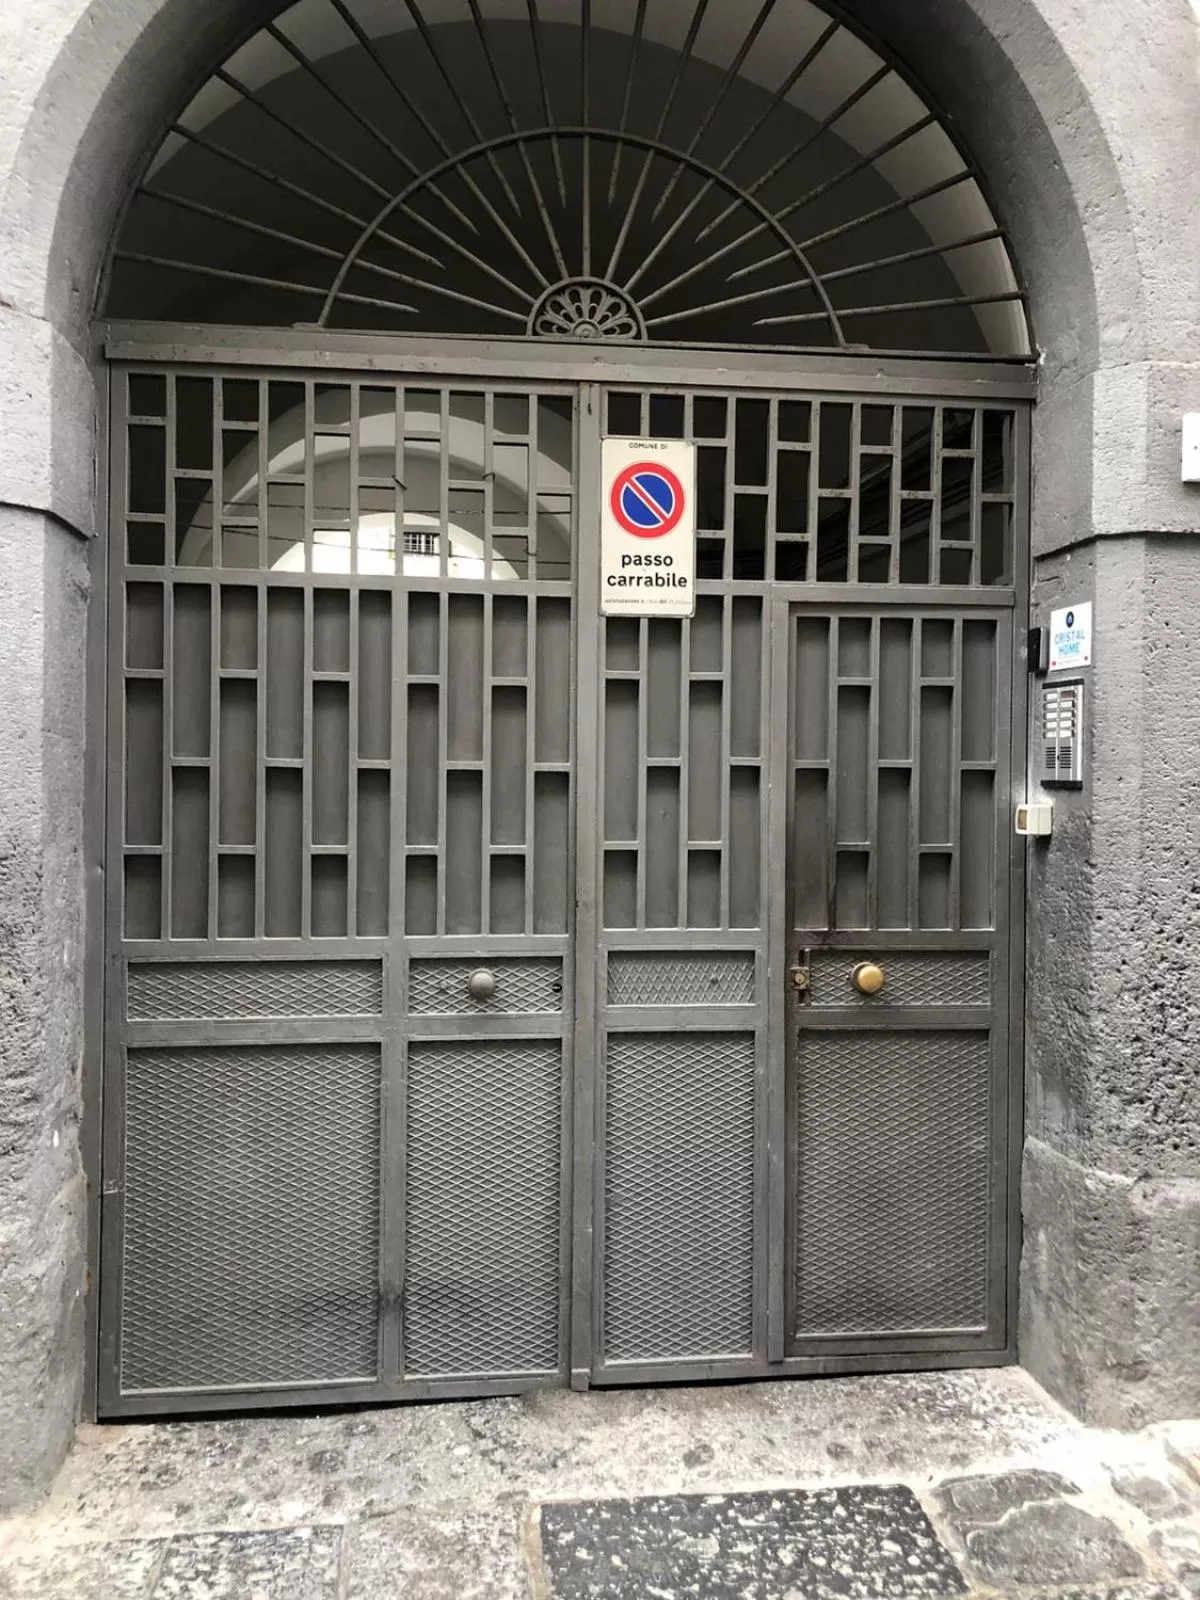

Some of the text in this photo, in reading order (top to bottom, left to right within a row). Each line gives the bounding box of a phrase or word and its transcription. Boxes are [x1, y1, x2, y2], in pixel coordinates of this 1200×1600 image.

[628, 442, 658, 450] COMUNE
[621, 554, 673, 569] passo
[607, 572, 688, 587] carrabile
[1054, 629, 1086, 645] CRISTAL
[1058, 642, 1081, 656] HOME
